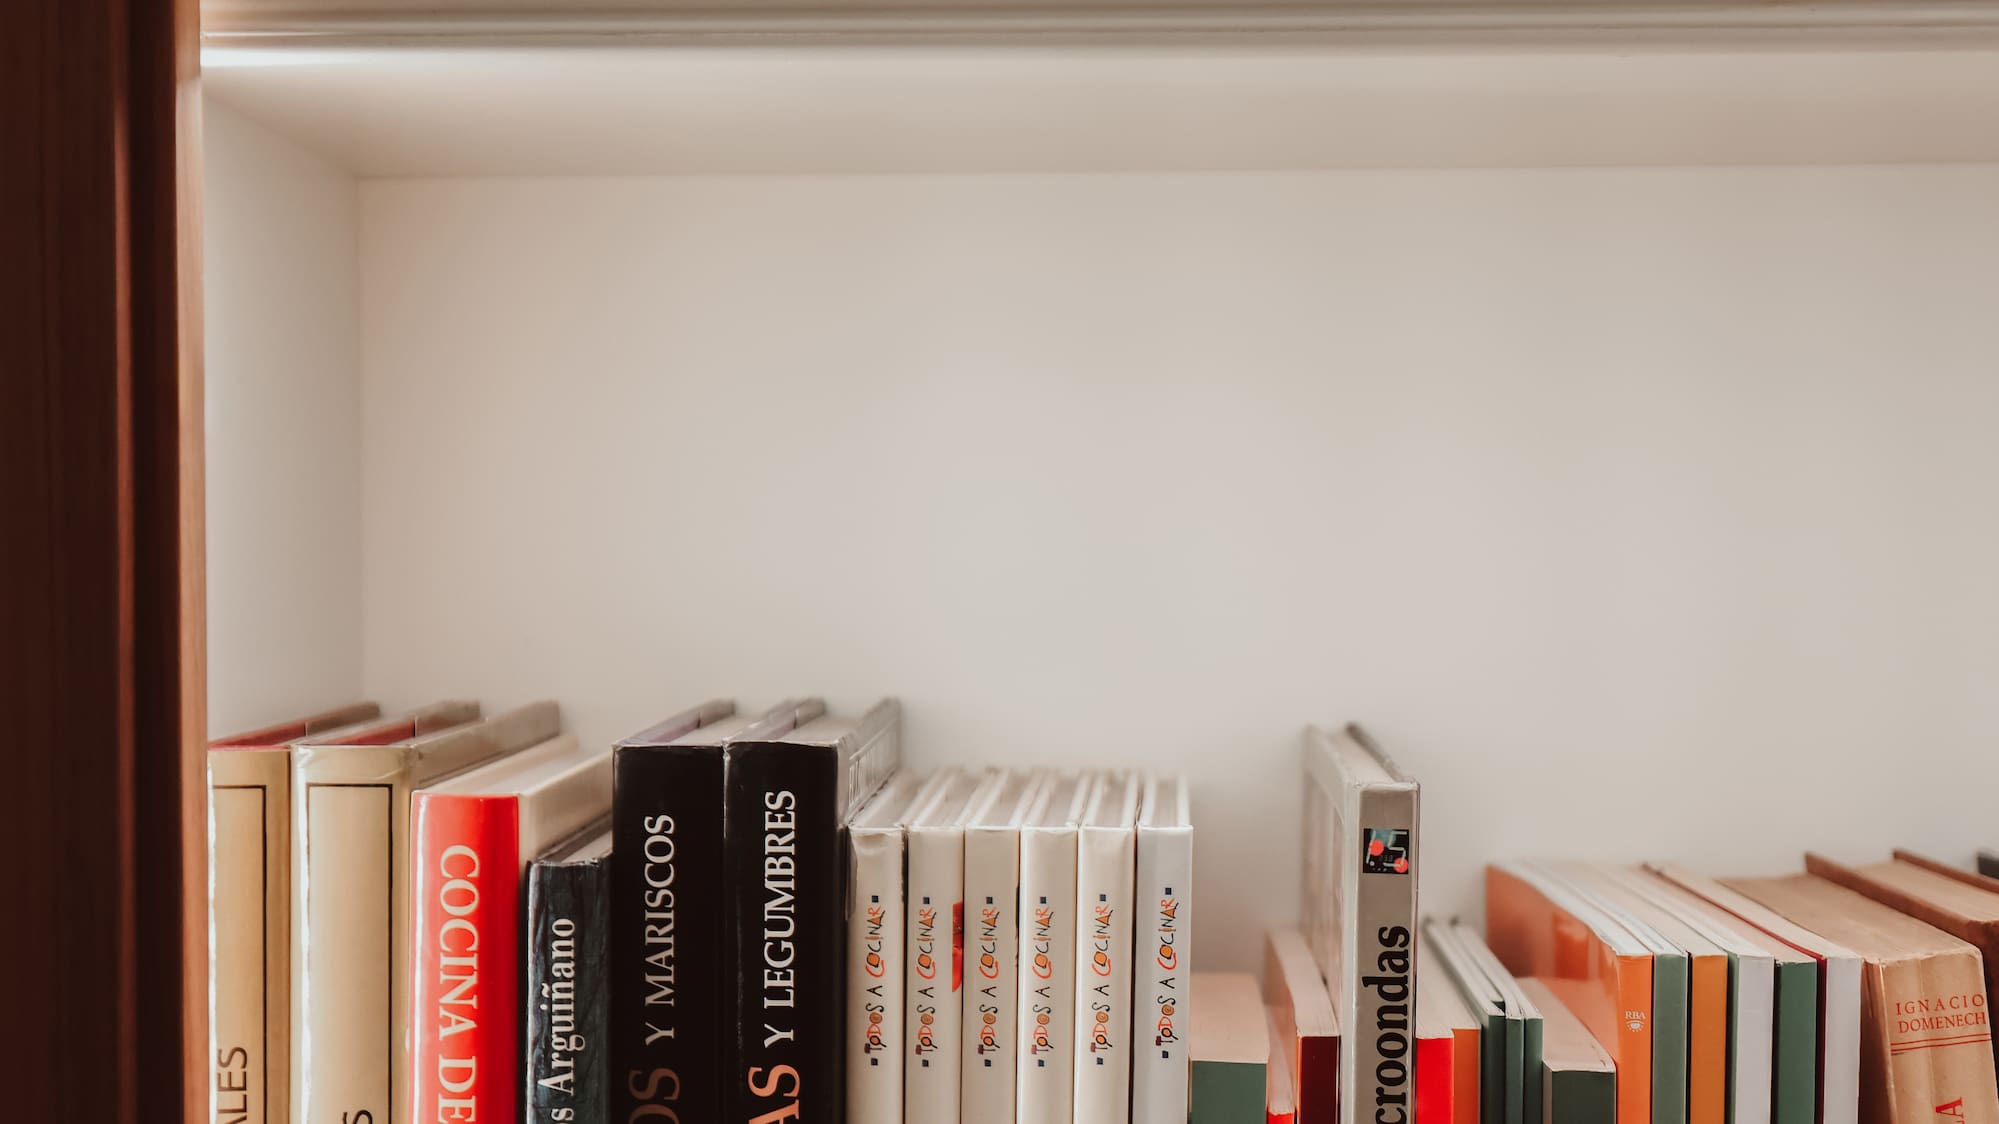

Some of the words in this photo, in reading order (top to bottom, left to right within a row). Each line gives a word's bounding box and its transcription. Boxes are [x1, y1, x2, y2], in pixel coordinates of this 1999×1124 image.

[644, 814, 675, 1007] MARISCOS
[763, 790, 796, 1009] LEGUMBRES
[1157, 897, 1180, 970] COCINAR
[438, 844, 480, 1041] COCINA
[865, 905, 886, 978] COCINAR
[916, 906, 937, 980] COCINAR
[979, 906, 1001, 979] COCINAR
[1032, 906, 1055, 979] COCINAR
[1092, 904, 1114, 976] COCINAR
[537, 918, 585, 1097] Arguiñano
[866, 985, 883, 997] A
[918, 986, 934, 998] A
[980, 986, 997, 998] A
[1034, 986, 1051, 998] A
[1093, 984, 1110, 996] A
[1159, 977, 1176, 989] A
[1625, 1010, 1646, 1020] RBA
[1895, 993, 1985, 1016] IGNACIO
[645, 1021, 675, 1046] Y
[763, 1022, 794, 1048] Y
[1362, 925, 1410, 1124] croondas
[1898, 1011, 1987, 1033] DOMENECH
[437, 1054, 477, 1124] DE
